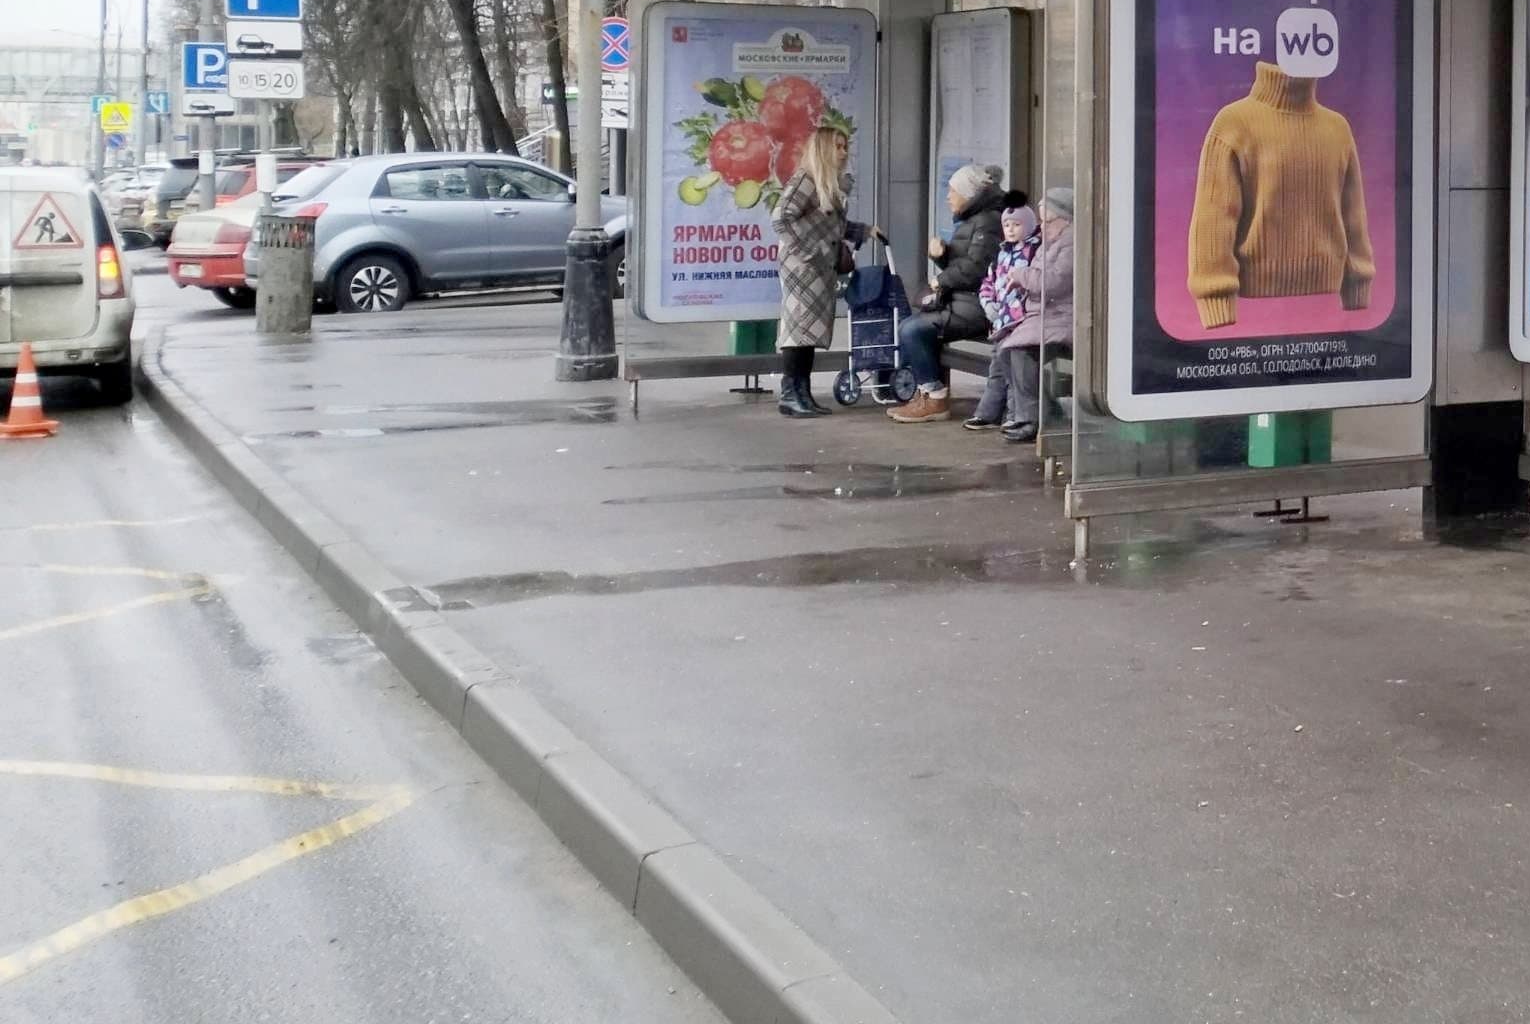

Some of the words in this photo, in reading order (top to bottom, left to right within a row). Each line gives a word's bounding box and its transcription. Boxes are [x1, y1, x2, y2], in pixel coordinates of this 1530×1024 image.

[1213, 27, 1261, 55] на
[1281, 23, 1334, 56] wb
[273, 73, 294, 88] 20
[673, 224, 762, 242] ЯРМАРКА
[673, 245, 745, 264] НОВОГО
[735, 269, 780, 280] МАСЛОВК
[1208, 347, 1228, 361] ООО
[1261, 344, 1284, 357] ОГРН
[1176, 363, 1237, 379] МОСКОВСКАЯ
